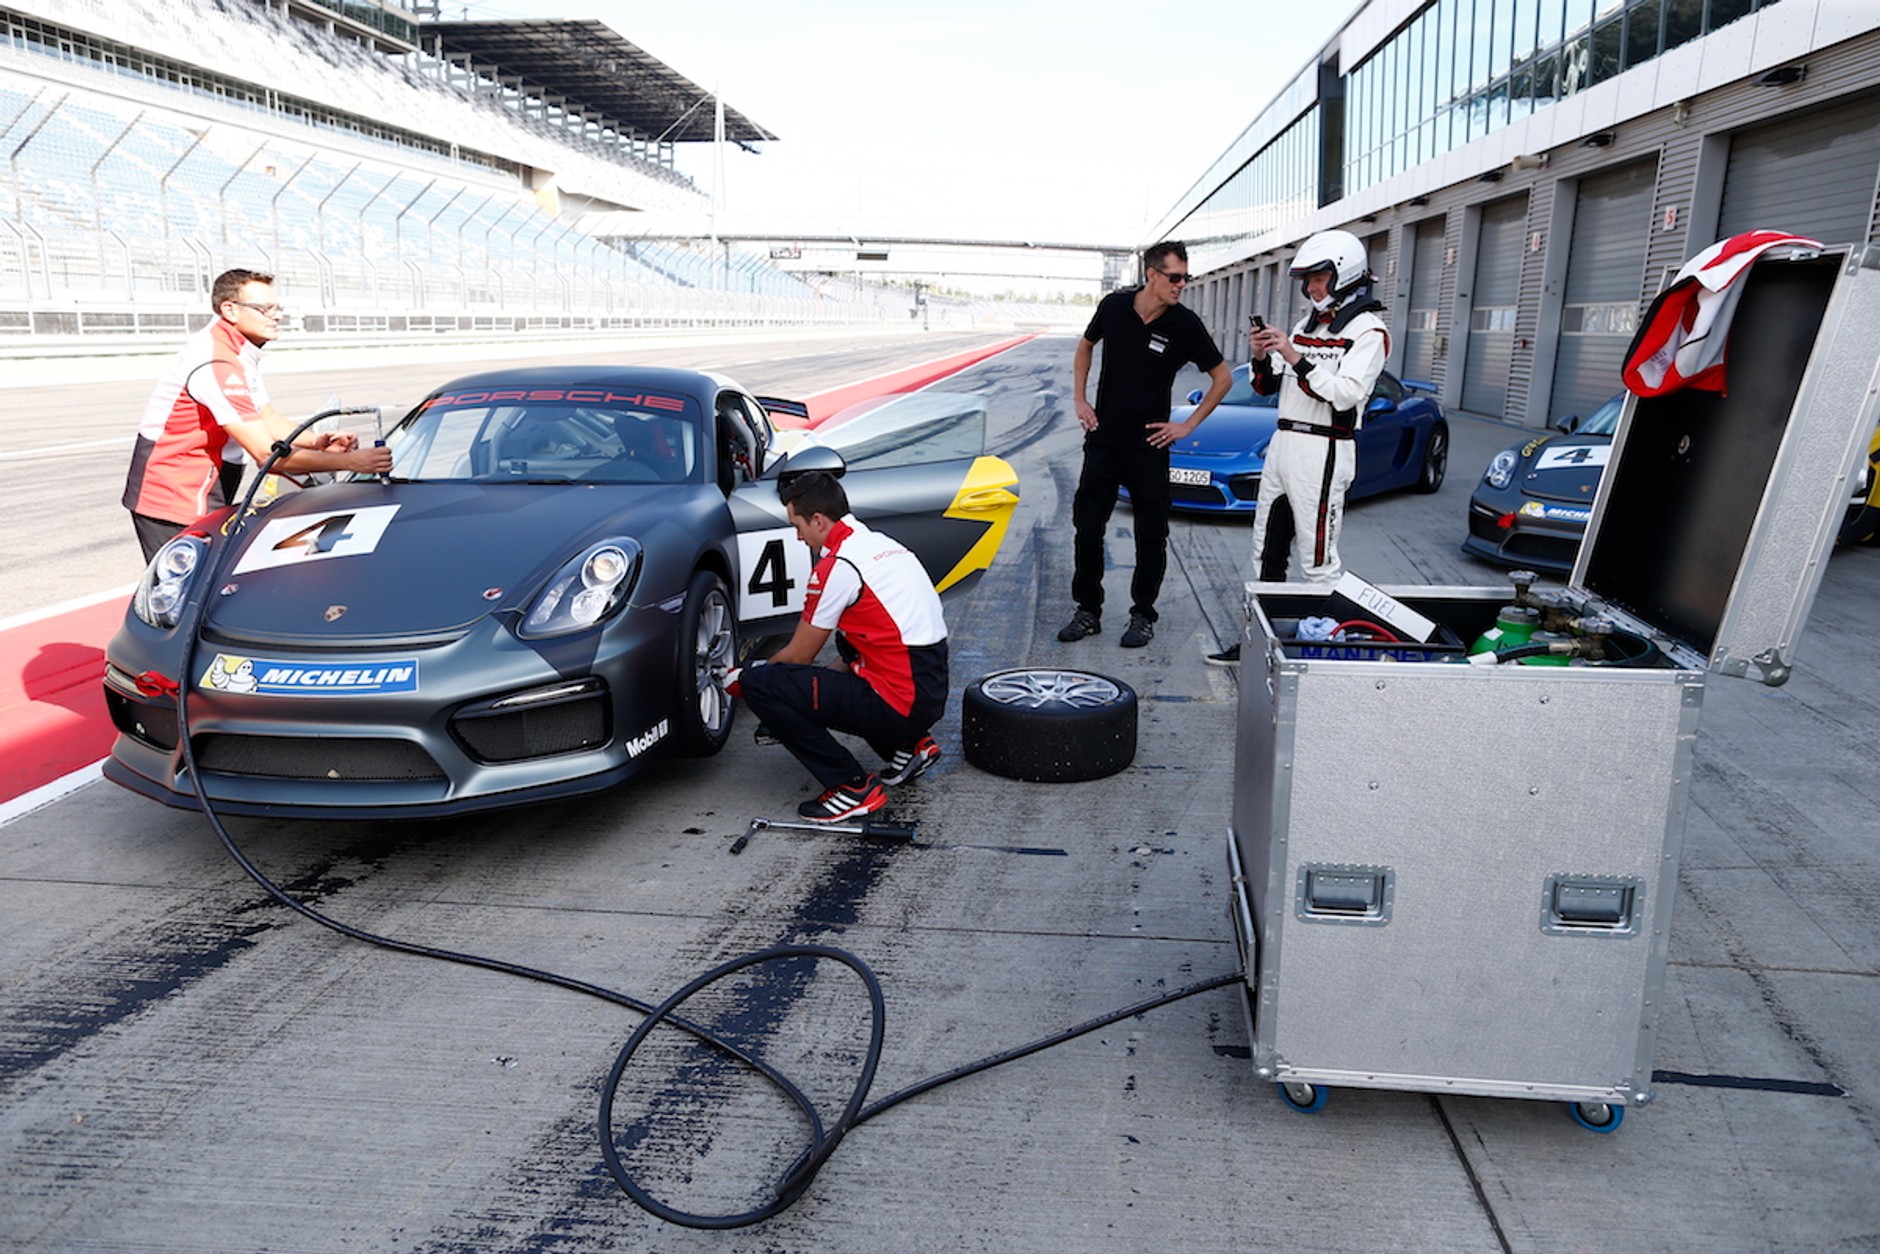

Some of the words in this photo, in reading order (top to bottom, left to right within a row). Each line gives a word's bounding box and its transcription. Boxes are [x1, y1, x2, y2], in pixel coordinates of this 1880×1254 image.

[420, 390, 685, 412] PORSCHE
[1553, 448, 1594, 464] 4
[1183, 471, 1209, 484] 1205
[271, 514, 356, 553] 4
[748, 539, 795, 608] 4
[1356, 586, 1397, 621] FUEL
[259, 667, 413, 685] MICHELIN
[625, 725, 659, 758] Mobil
